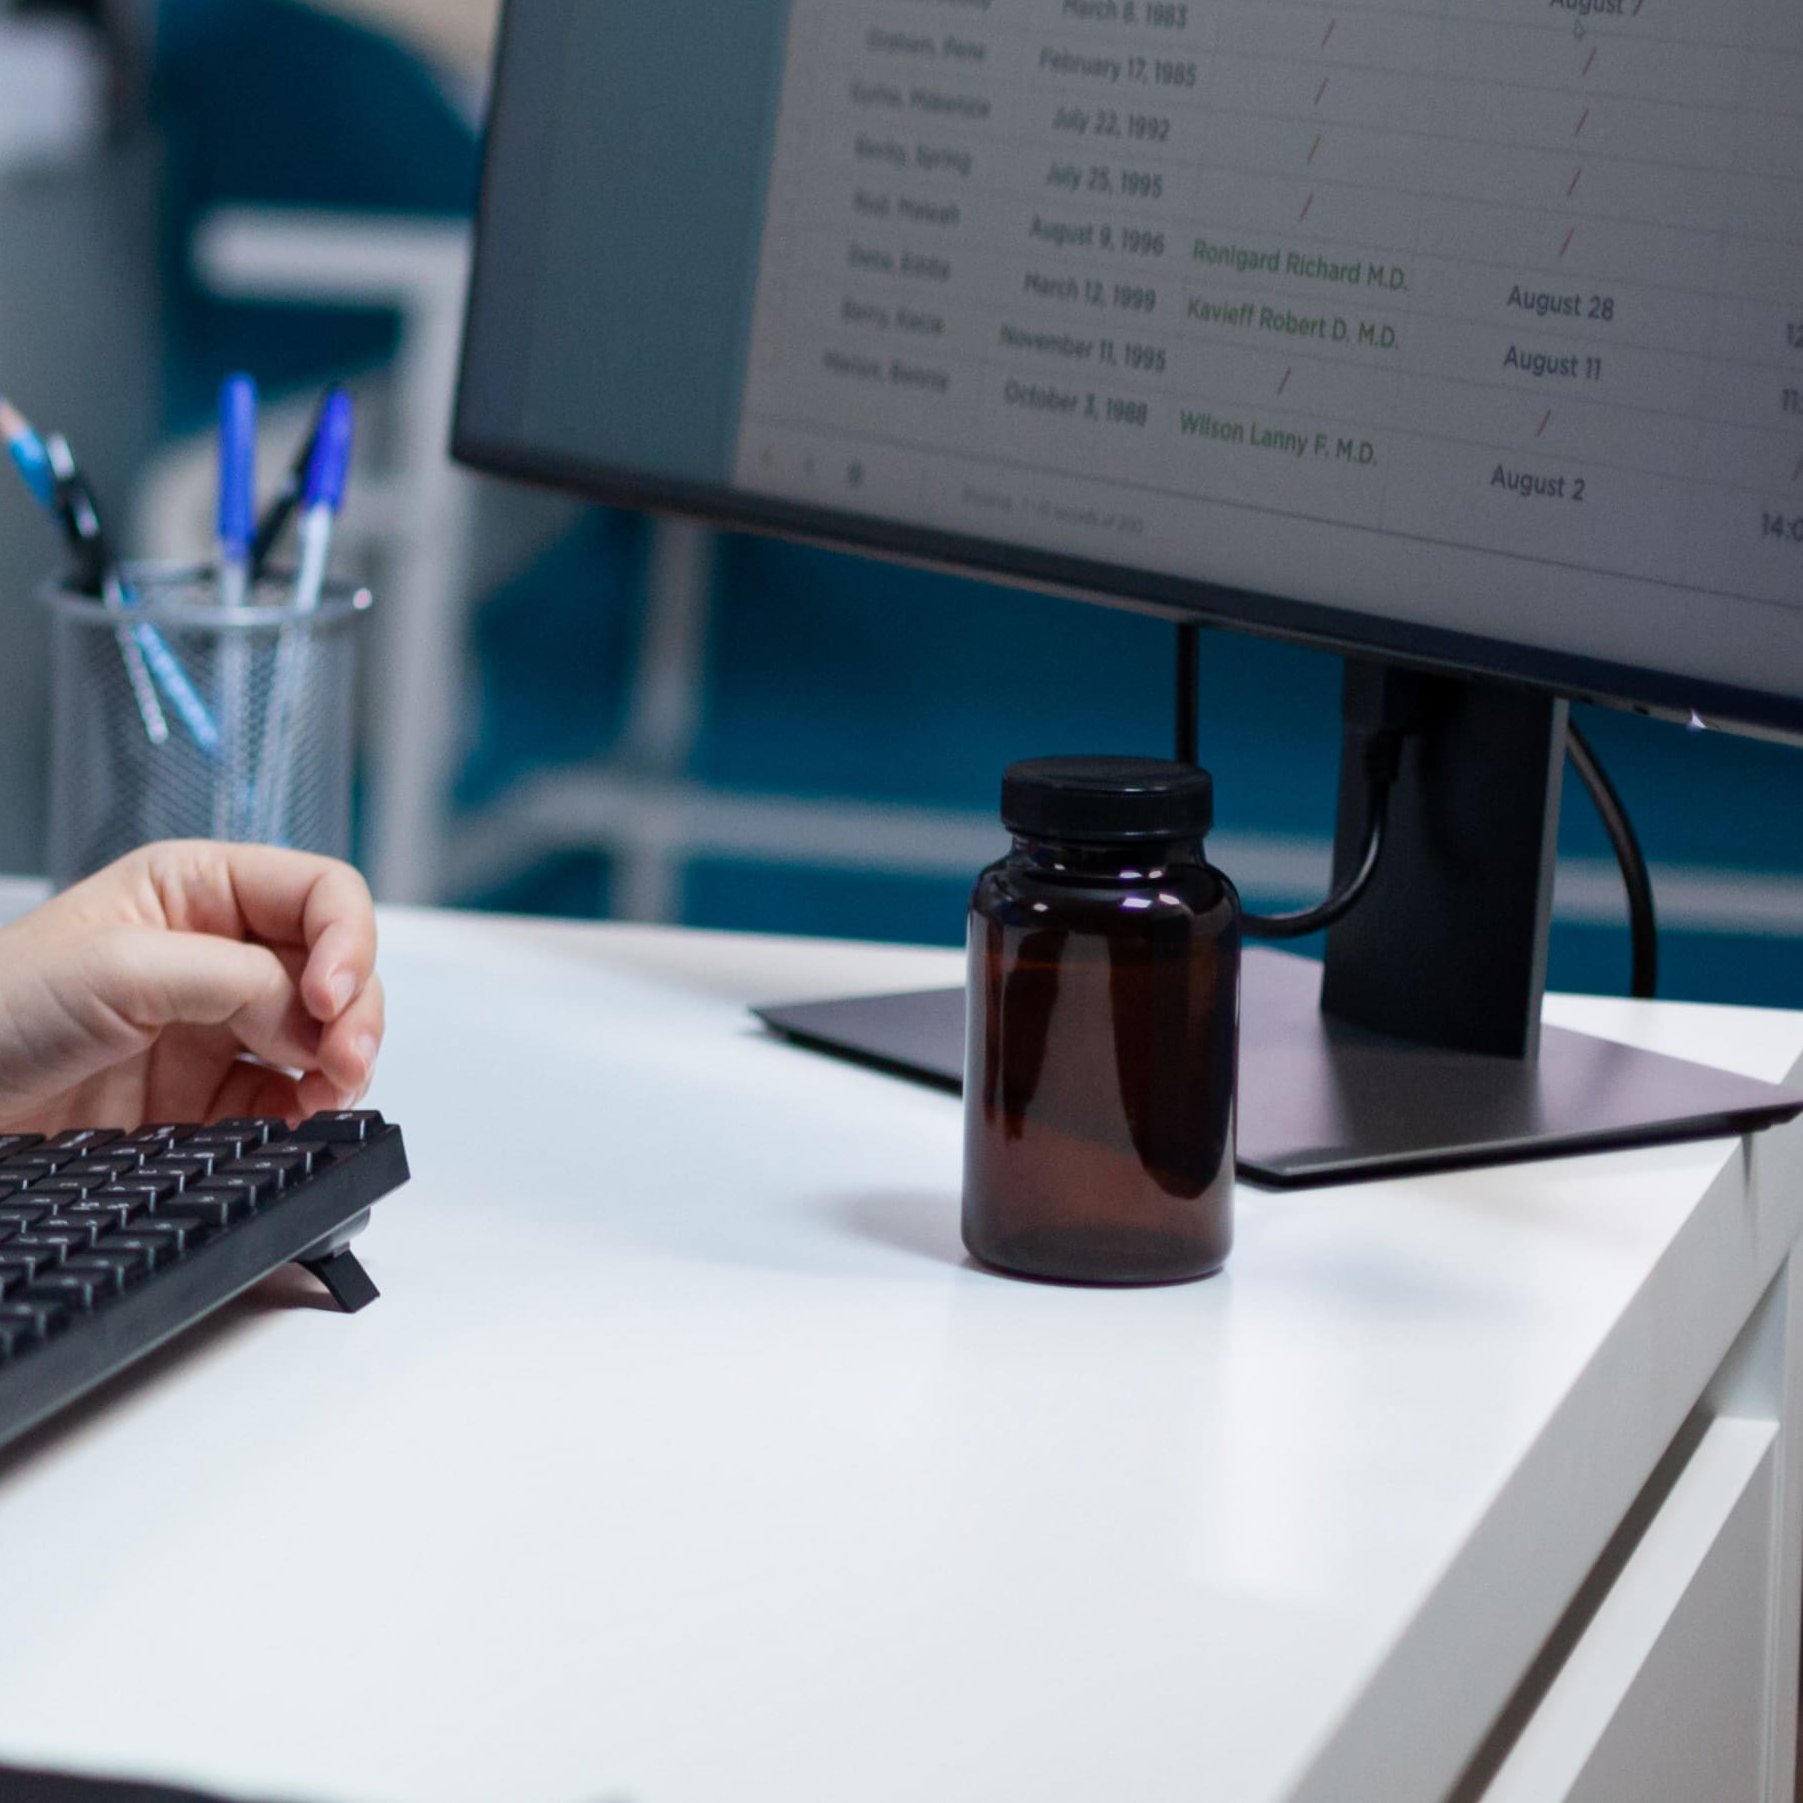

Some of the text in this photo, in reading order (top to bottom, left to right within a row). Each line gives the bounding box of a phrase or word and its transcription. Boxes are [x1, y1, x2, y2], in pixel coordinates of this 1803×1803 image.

[1146, 2, 1188, 30] 1983
[1039, 46, 1122, 83] February
[1155, 59, 1198, 89] 1985
[1052, 106, 1090, 137] July
[1128, 112, 1172, 143] 1992
[1045, 162, 1083, 192] July
[1120, 169, 1164, 199] 1995
[1029, 213, 1095, 248] August
[1121, 226, 1166, 257] 1996
[1192, 237, 1409, 292] Ronigard Richard M.D.
[1023, 270, 1079, 302] March
[1113, 283, 1157, 314] 1999
[1506, 284, 1615, 322] August 28
[1187, 296, 1400, 351] Kavieff Robert D. M.D.
[999, 321, 1094, 361] November
[1123, 342, 1168, 373] 1995
[1503, 345, 1602, 382] August 11
[1003, 377, 1079, 414] October
[1106, 396, 1149, 428] 1988
[1178, 408, 1379, 467] Wilson Lanny F. M.D.
[1489, 463, 1586, 502] August 2
